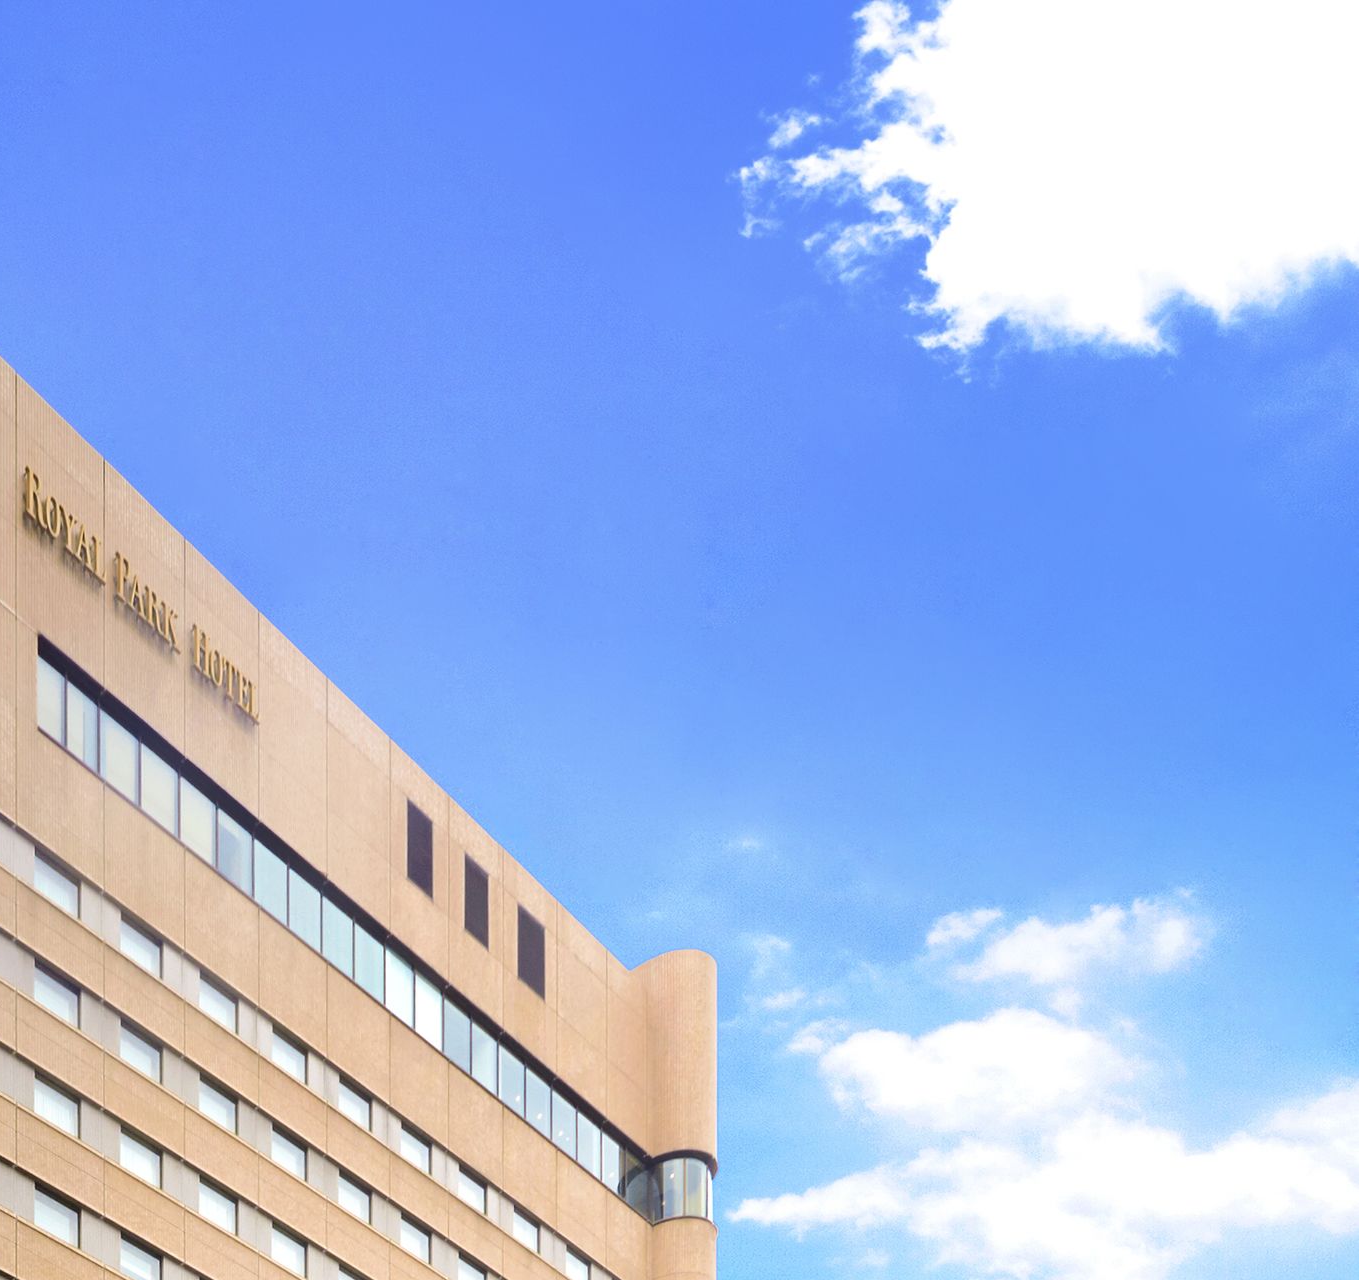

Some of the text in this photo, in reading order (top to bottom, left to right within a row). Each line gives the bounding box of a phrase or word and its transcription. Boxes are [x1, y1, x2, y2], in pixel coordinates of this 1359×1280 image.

[23, 465, 260, 725] ROYAL PARK HOTEL
